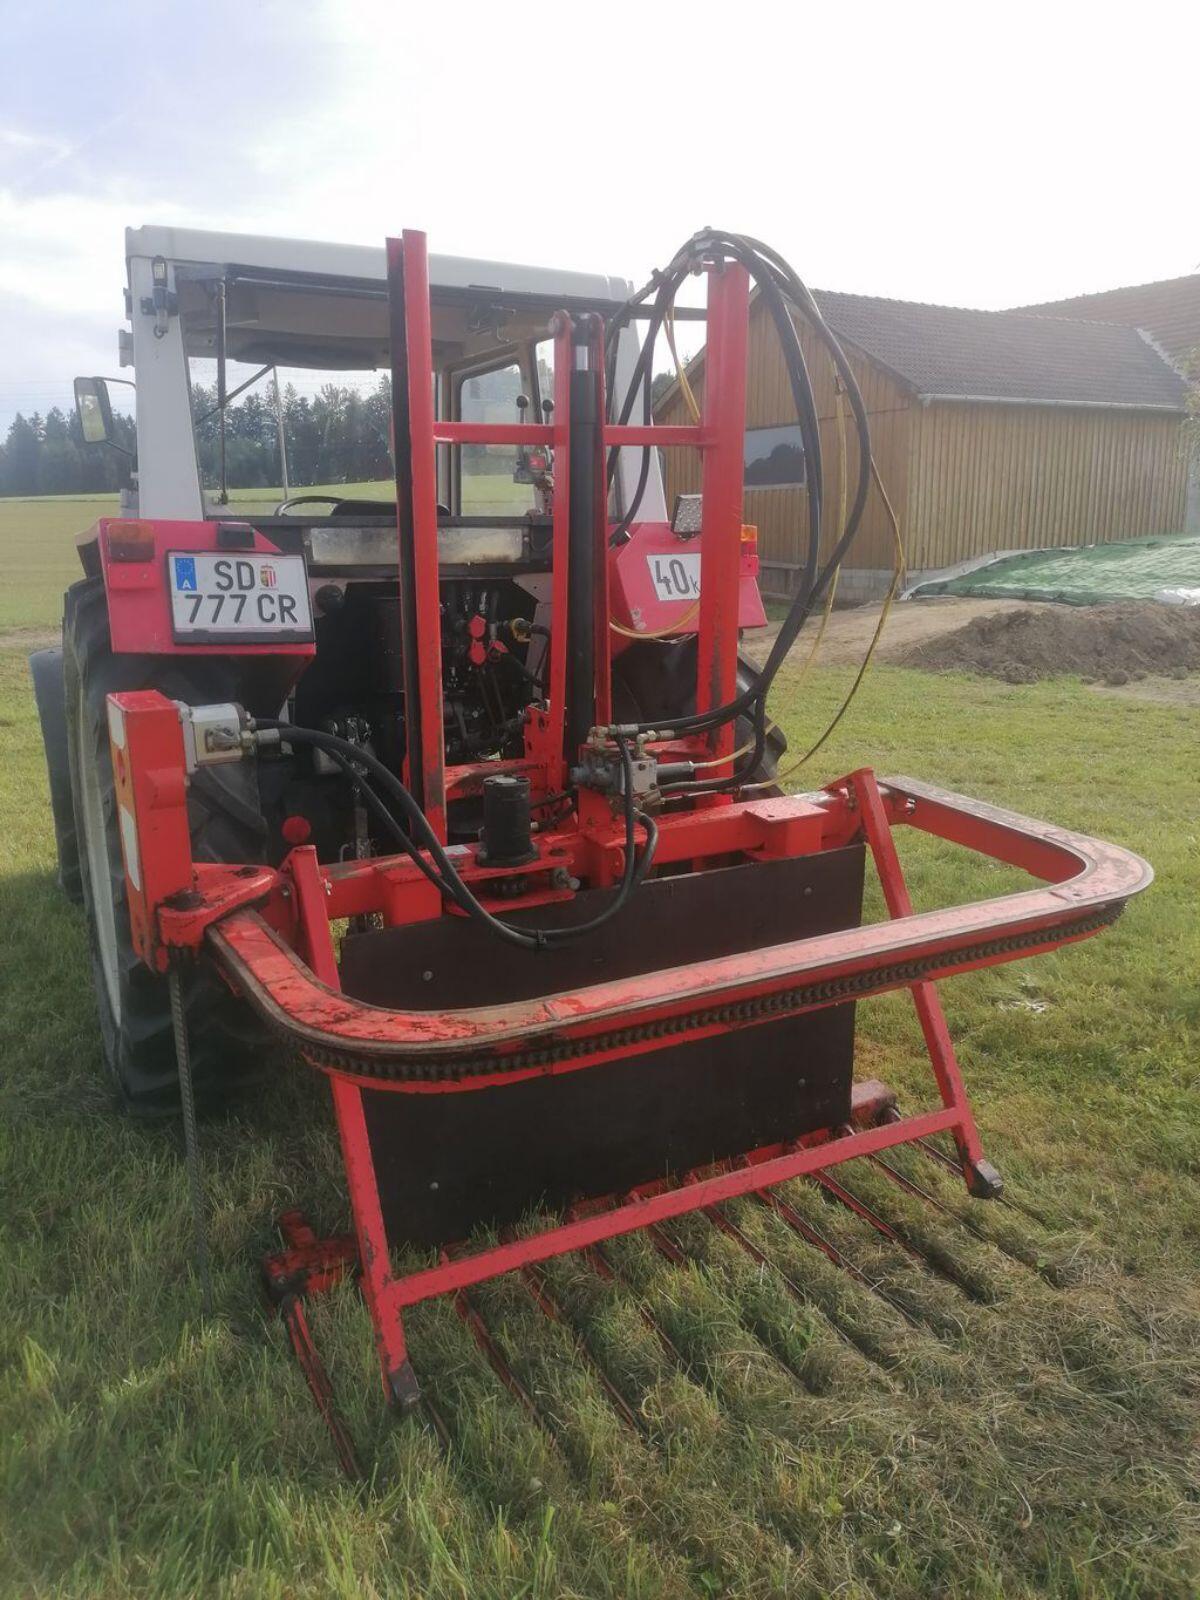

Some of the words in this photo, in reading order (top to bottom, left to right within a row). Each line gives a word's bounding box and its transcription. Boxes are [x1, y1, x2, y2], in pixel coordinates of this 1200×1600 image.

[182, 579, 192, 589] A
[214, 560, 255, 591] SD
[184, 593, 247, 624] 777
[257, 593, 298, 624] CR
